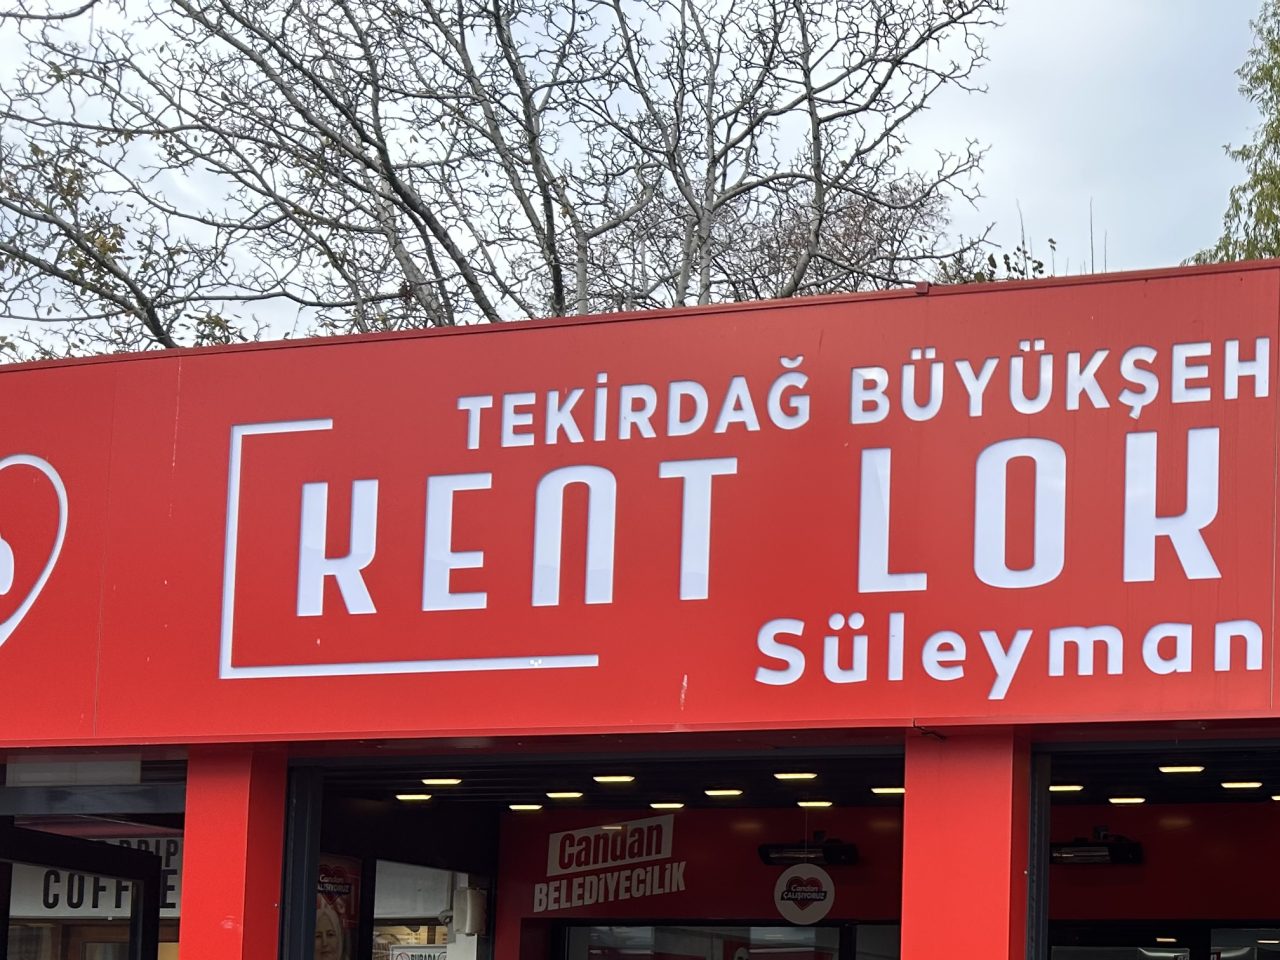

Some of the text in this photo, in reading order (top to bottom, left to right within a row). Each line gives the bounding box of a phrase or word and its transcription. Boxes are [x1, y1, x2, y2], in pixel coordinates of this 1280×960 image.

[457, 355, 811, 450] TEKİRDAĞ
[297, 457, 738, 617] KENT
[558, 823, 663, 869] Candan
[42, 869, 178, 909] COFFE
[533, 861, 687, 913] BELEDİYECİLİK
